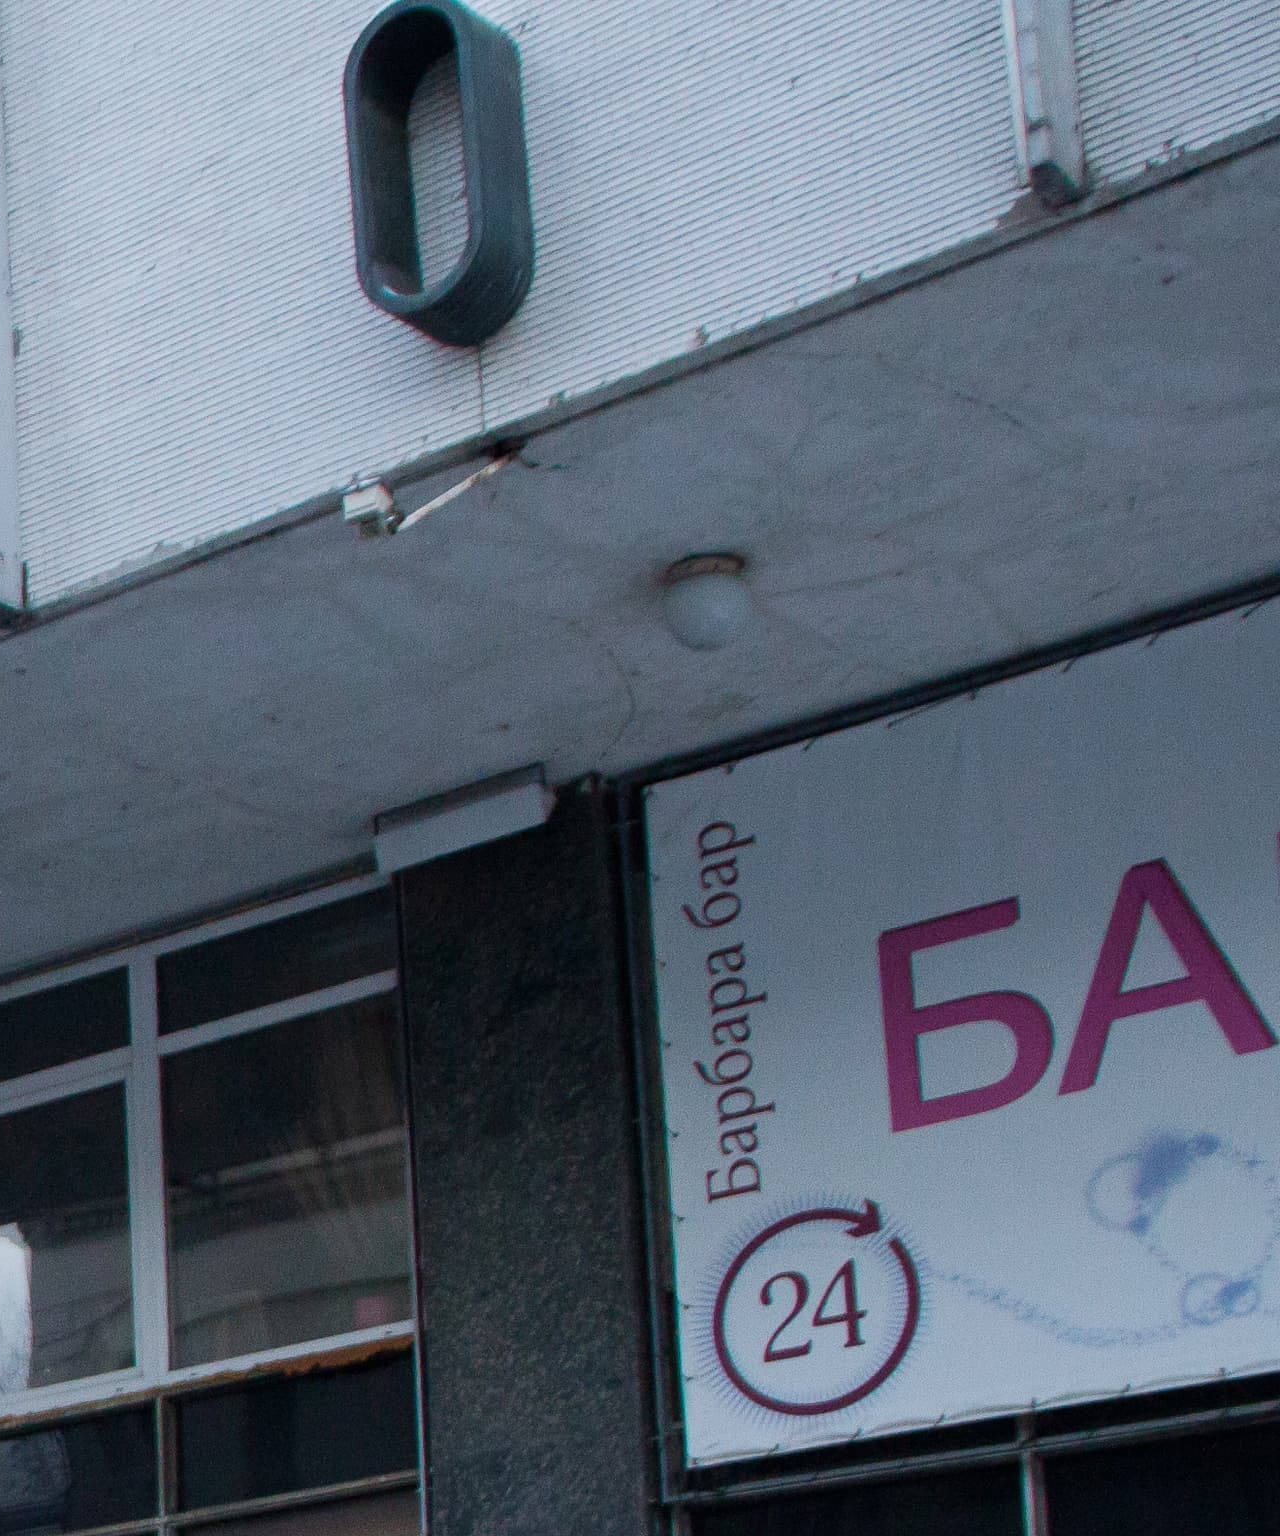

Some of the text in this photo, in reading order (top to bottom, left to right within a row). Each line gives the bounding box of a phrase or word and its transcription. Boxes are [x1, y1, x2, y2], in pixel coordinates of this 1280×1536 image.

[683, 819, 777, 1204] Барбара бар
[877, 830, 1280, 1134] БА
[758, 1259, 868, 1364] 24
